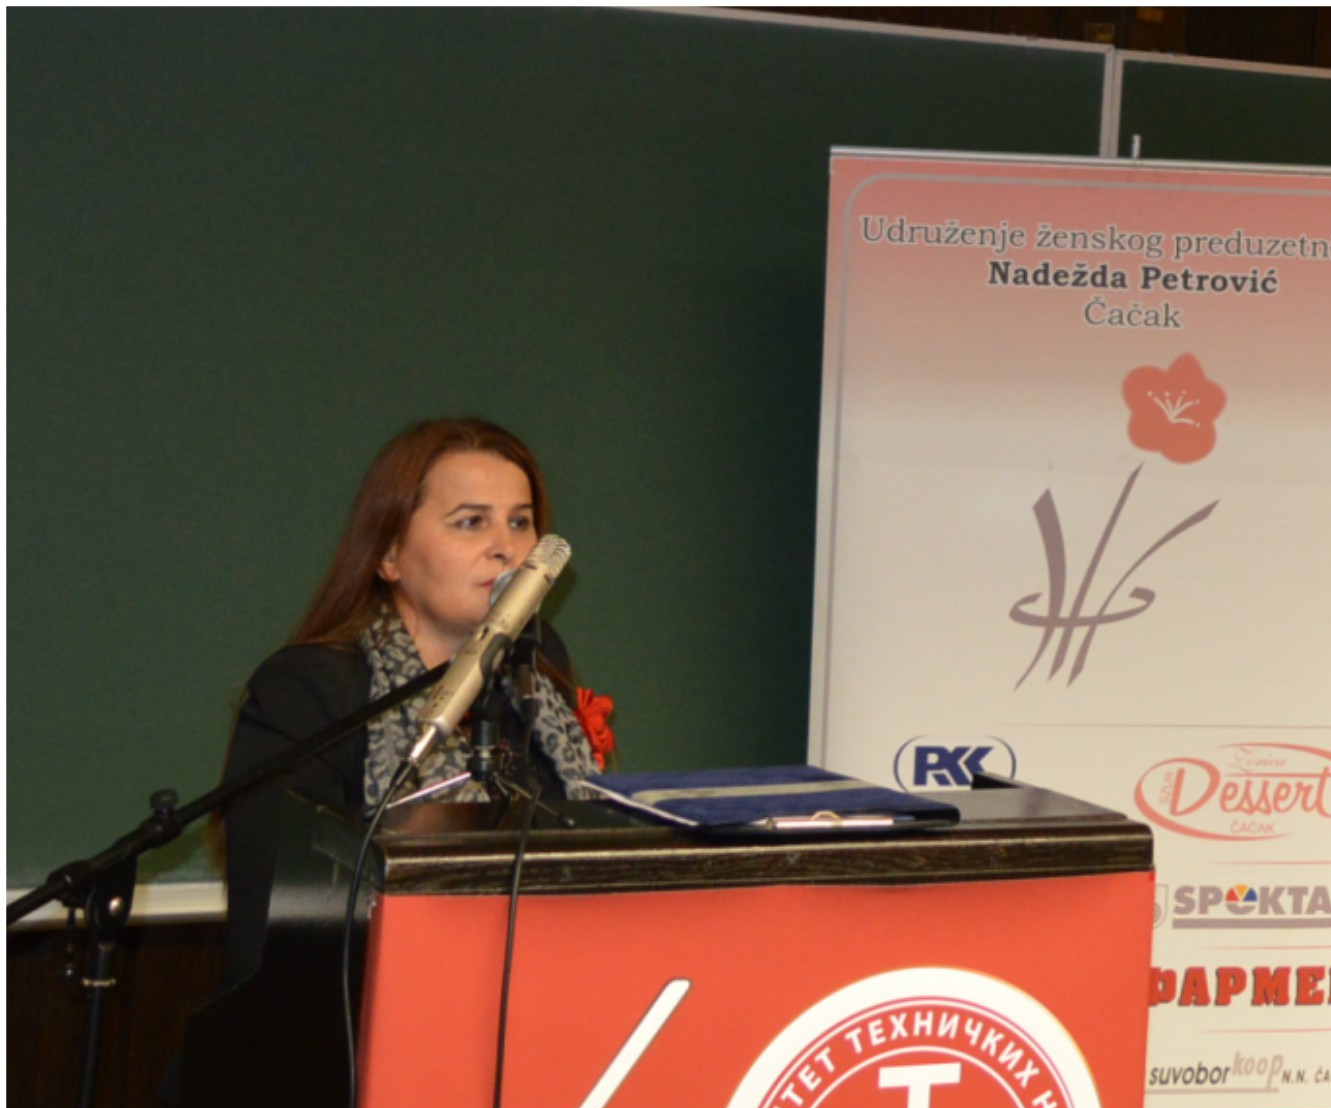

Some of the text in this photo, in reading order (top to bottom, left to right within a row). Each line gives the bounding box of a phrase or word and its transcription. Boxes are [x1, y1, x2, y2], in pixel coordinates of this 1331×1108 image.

[861, 216, 1026, 253] Udruženje
[1036, 223, 1164, 259] ženskog
[988, 261, 1279, 295] Nadežda Petrović
[1084, 296, 1181, 329] Čačak
[1230, 819, 1276, 835] ČAČAK
[844, 1010, 1041, 1088] ТЕХНИЧКИХ
